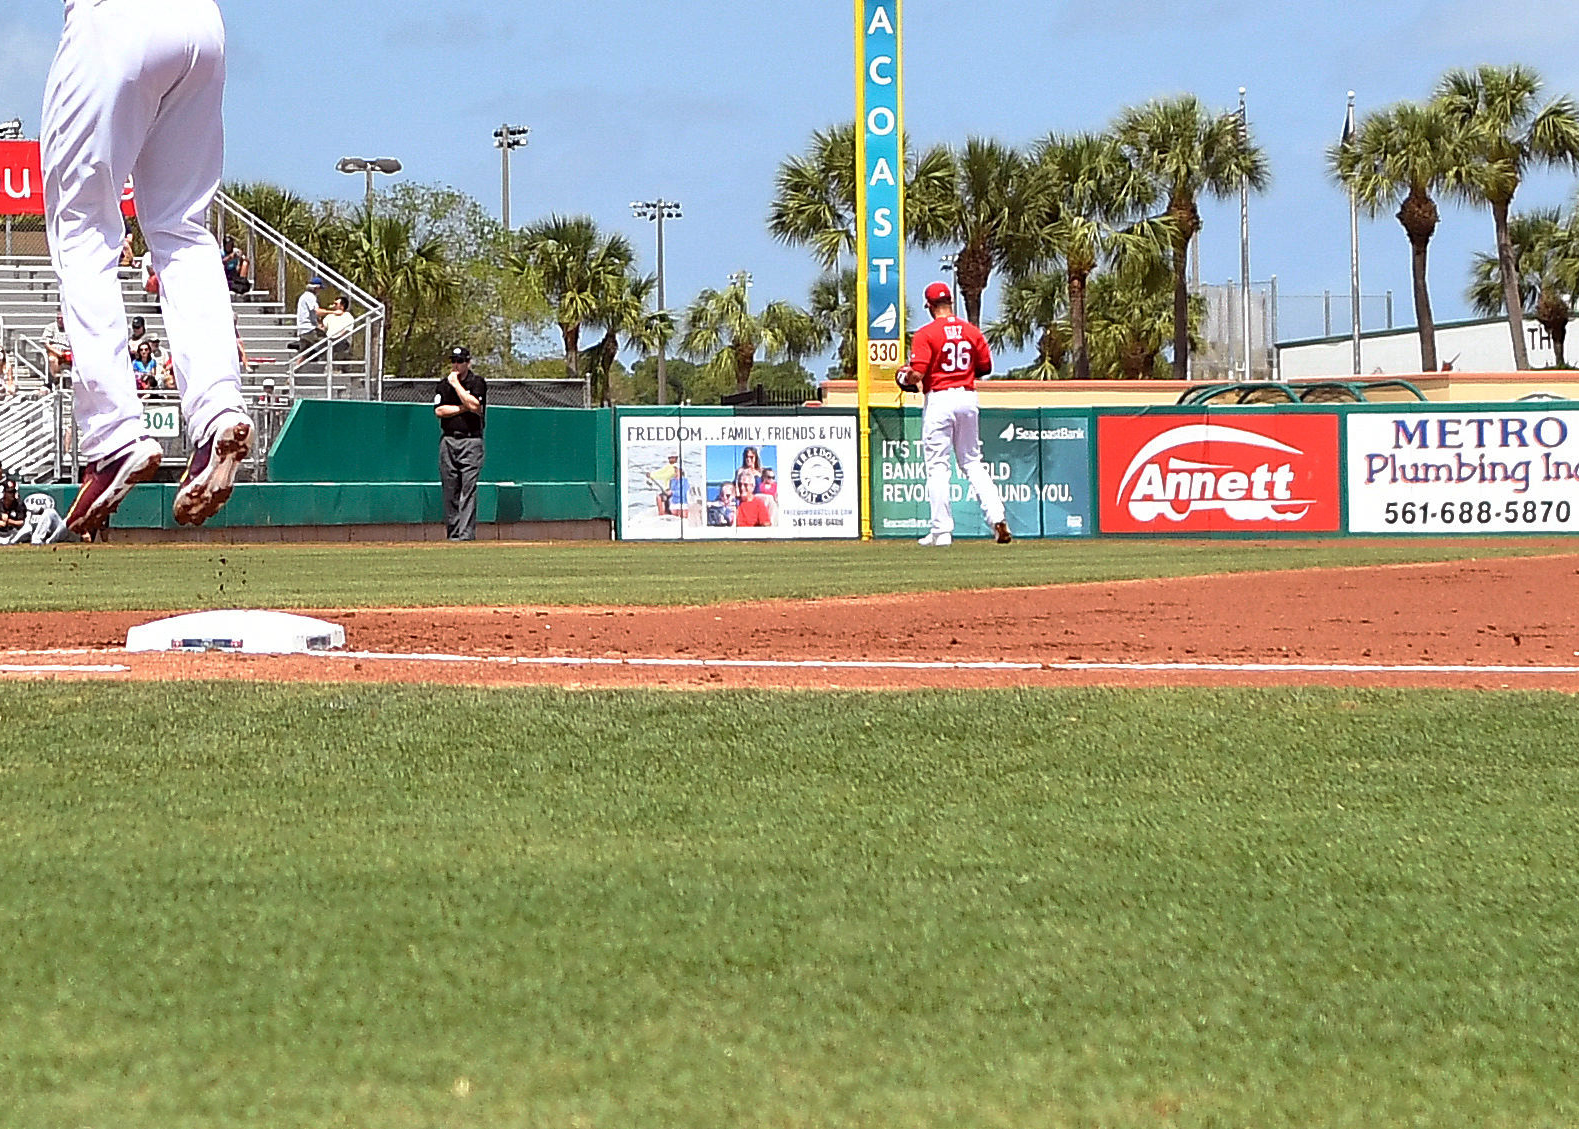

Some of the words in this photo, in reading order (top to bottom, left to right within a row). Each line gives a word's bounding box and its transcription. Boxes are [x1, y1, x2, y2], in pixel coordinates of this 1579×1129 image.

[869, 342, 898, 362] 330
[941, 340, 972, 372] 36
[144, 412, 174, 430] 304
[768, 426, 815, 440] FRIENDS
[830, 426, 852, 440] FUN
[1392, 416, 1568, 449] METRO
[882, 439, 910, 459] IT'S
[1129, 463, 1295, 500] Annett
[1363, 451, 1532, 493] Plumbing
[1384, 500, 1571, 525] 561-688-5870
